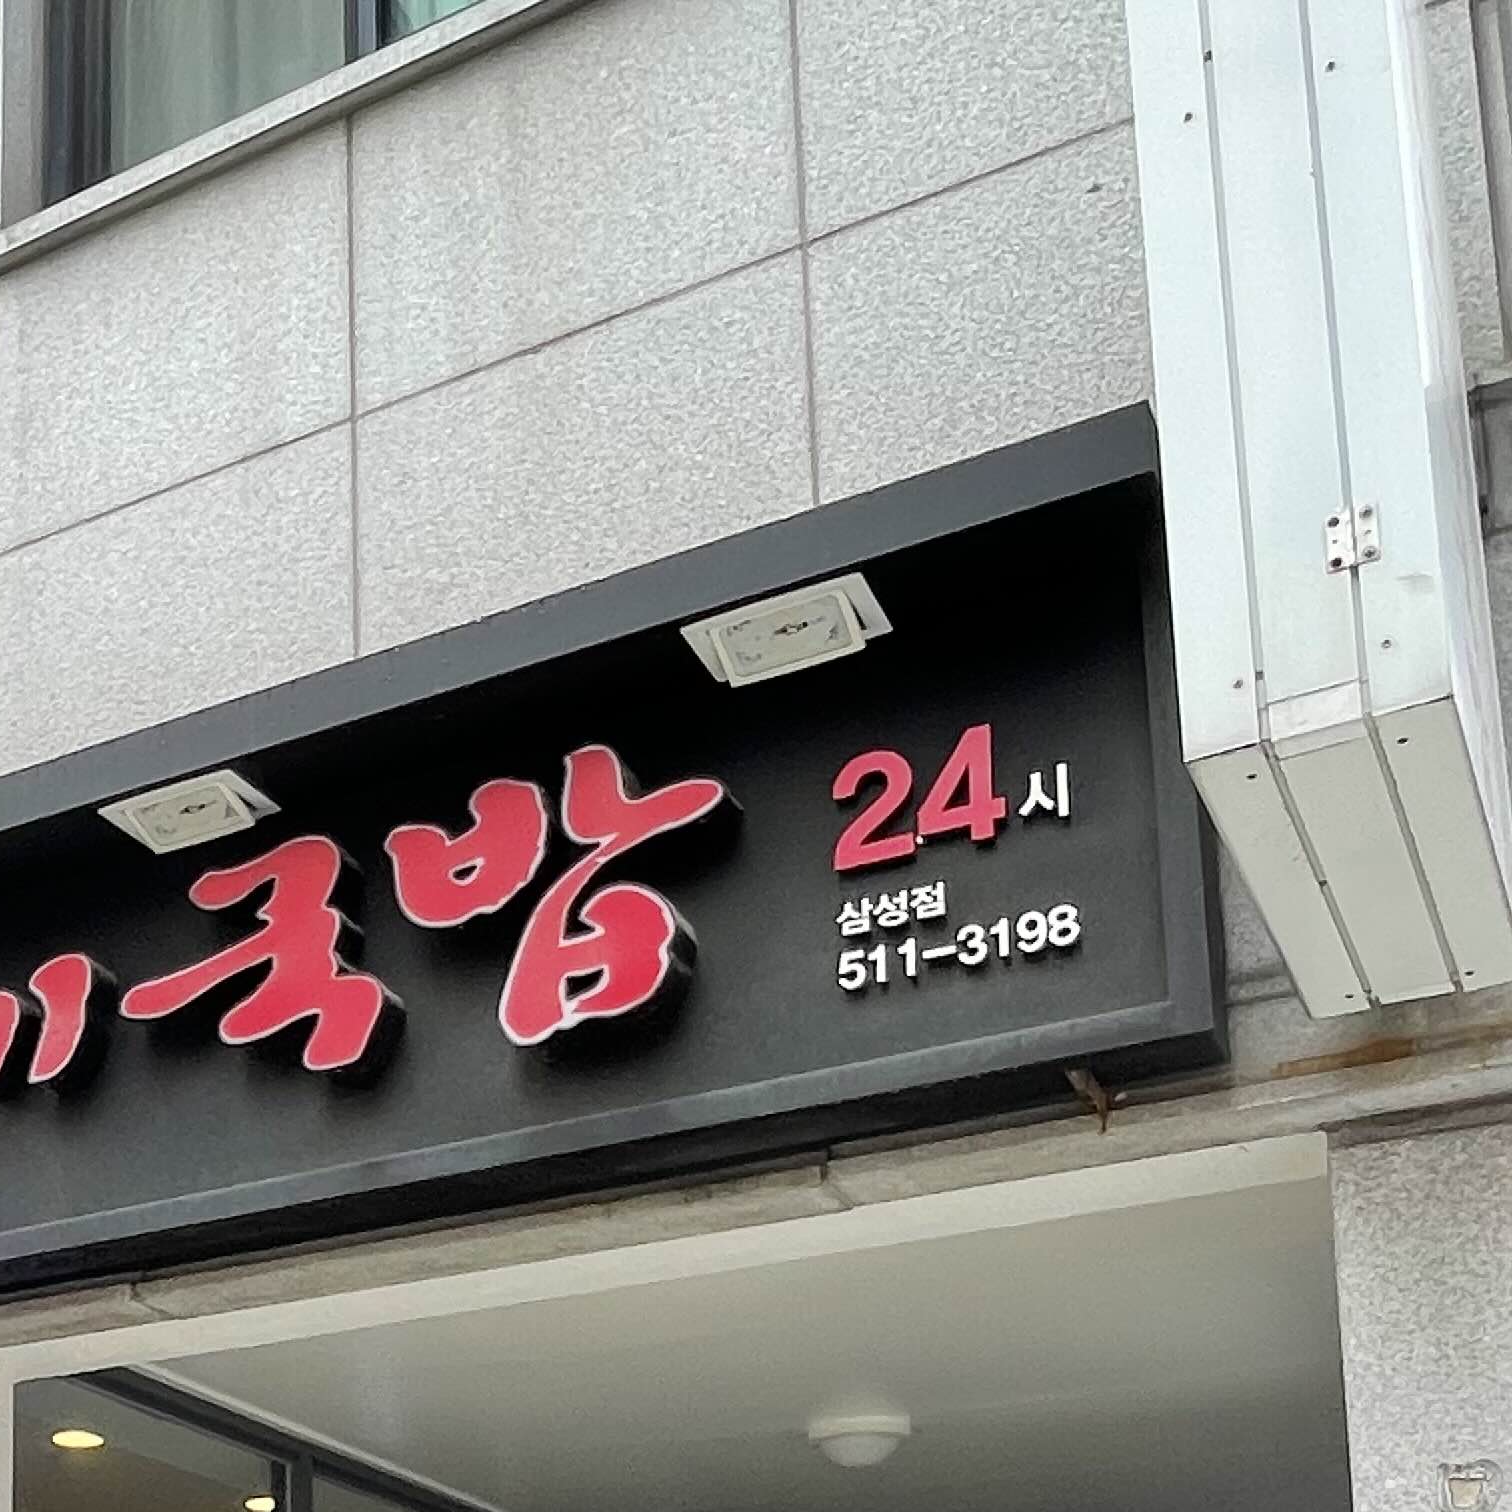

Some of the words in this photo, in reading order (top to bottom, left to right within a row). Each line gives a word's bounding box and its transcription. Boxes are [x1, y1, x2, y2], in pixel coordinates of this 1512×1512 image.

[832, 722, 1072, 871] 24시
[836, 881, 948, 937] 삼성점
[837, 903, 1081, 991] 511-3198
